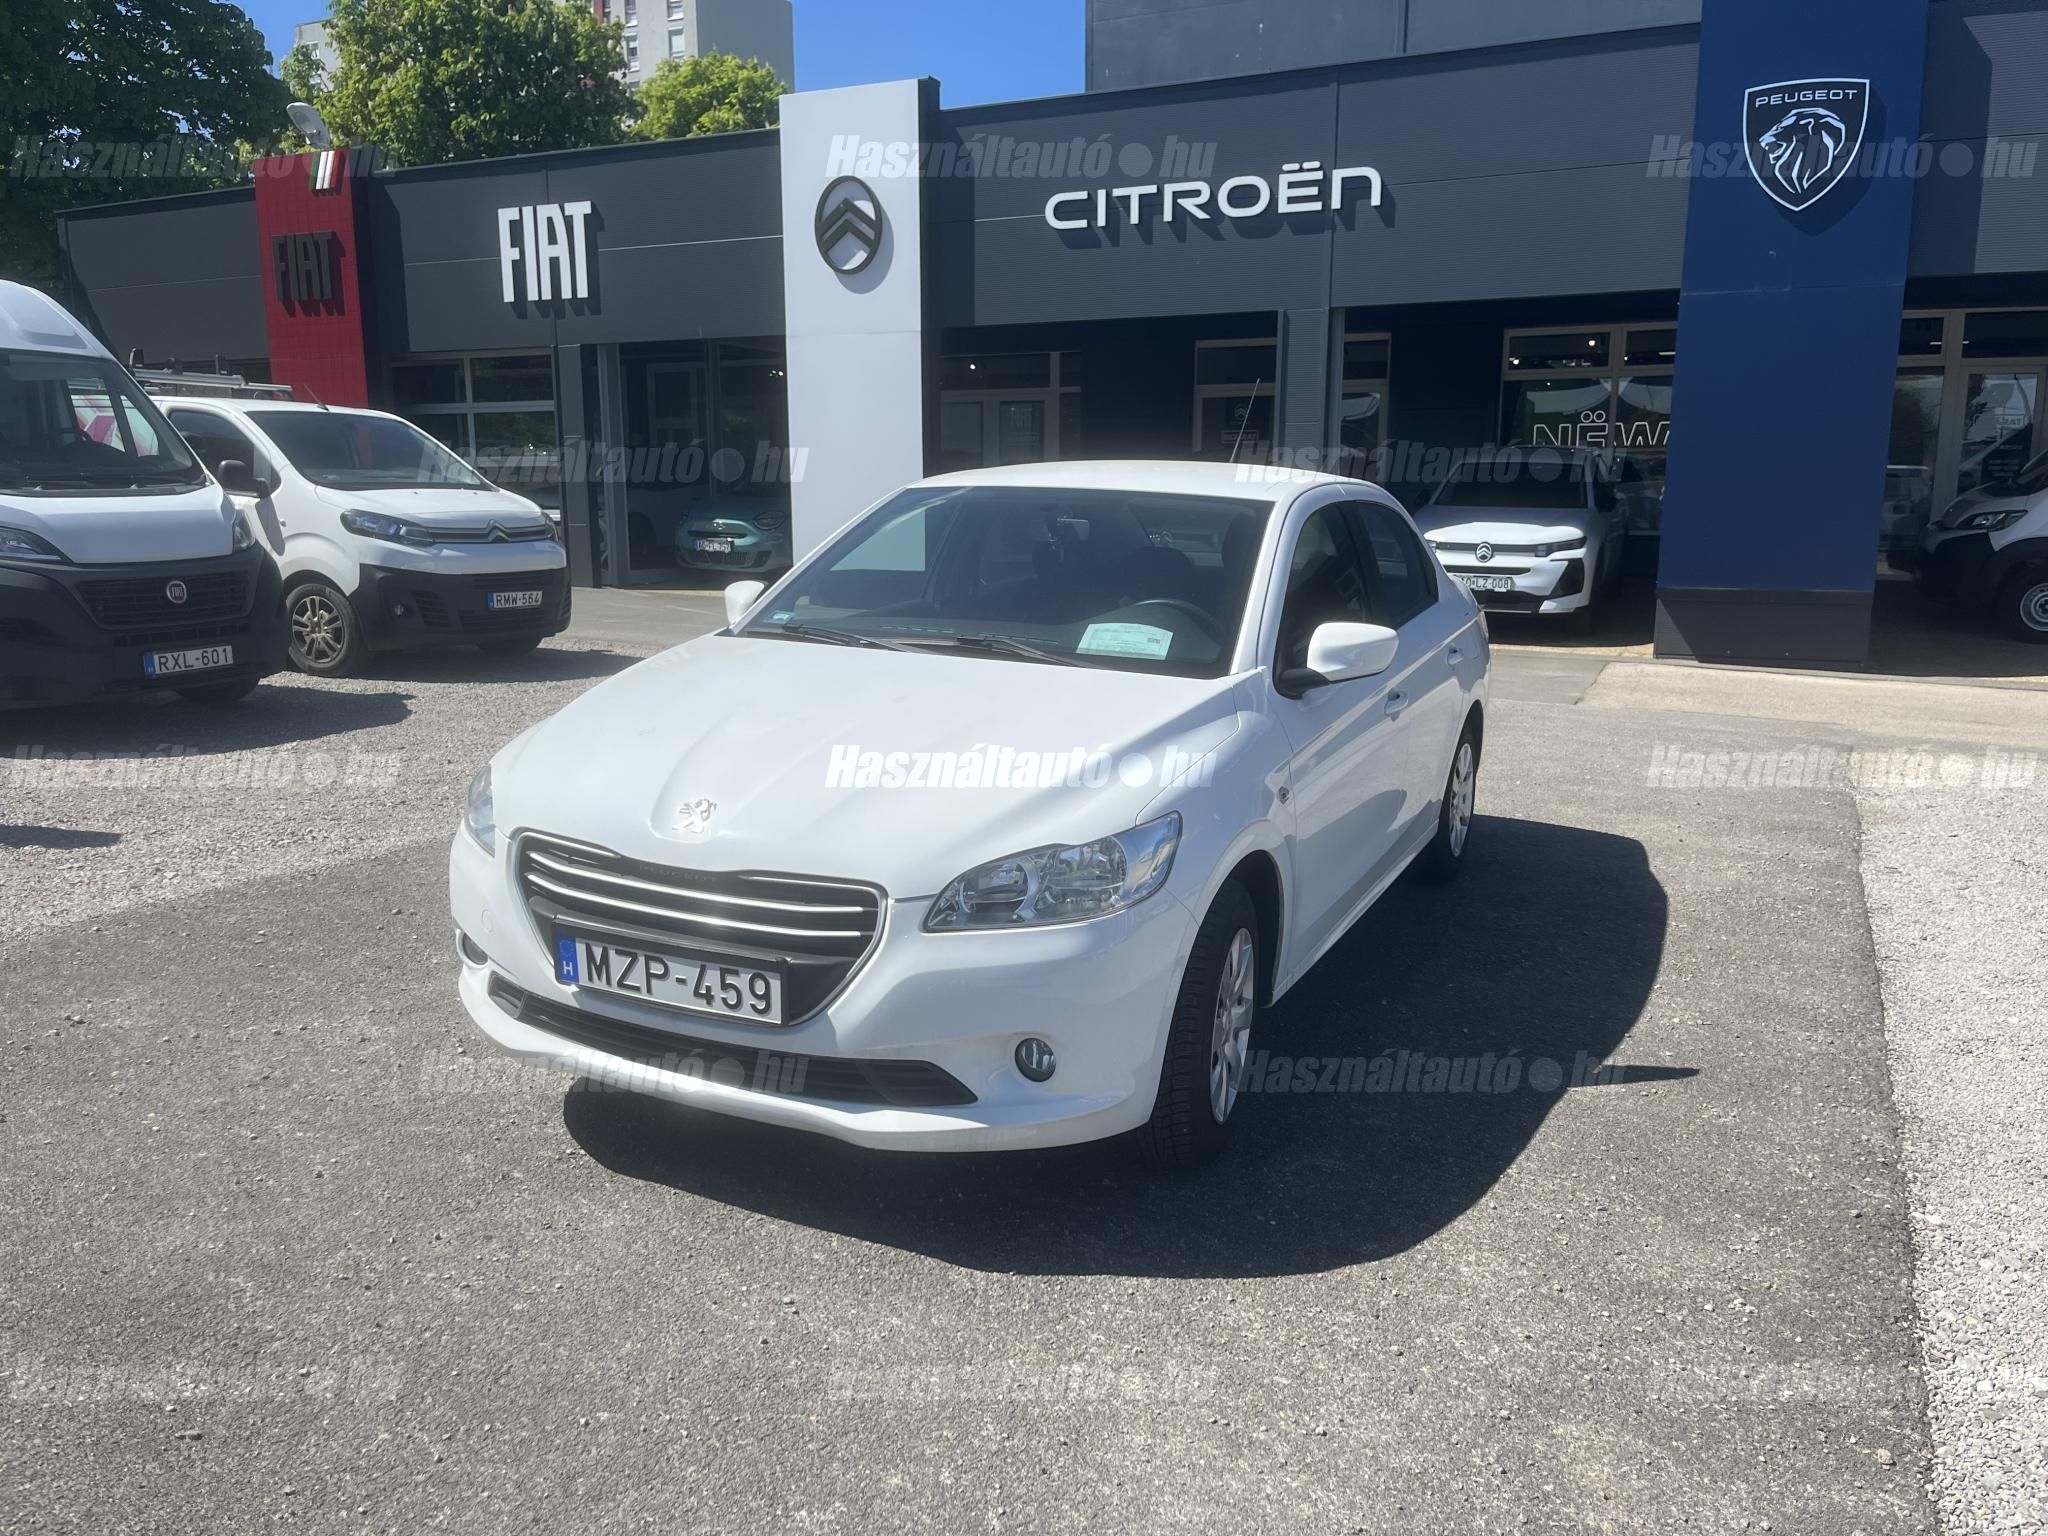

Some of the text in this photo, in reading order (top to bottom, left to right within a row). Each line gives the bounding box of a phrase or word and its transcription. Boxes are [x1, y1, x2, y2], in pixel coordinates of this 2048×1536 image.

[1755, 89, 1858, 108] PEUGEOT
[271, 231, 334, 304] FIAT
[498, 200, 592, 303] FIAT
[496, 592, 540, 607] RMW-564
[158, 647, 229, 672] RXL-601
[584, 942, 772, 1016] MZP-459
